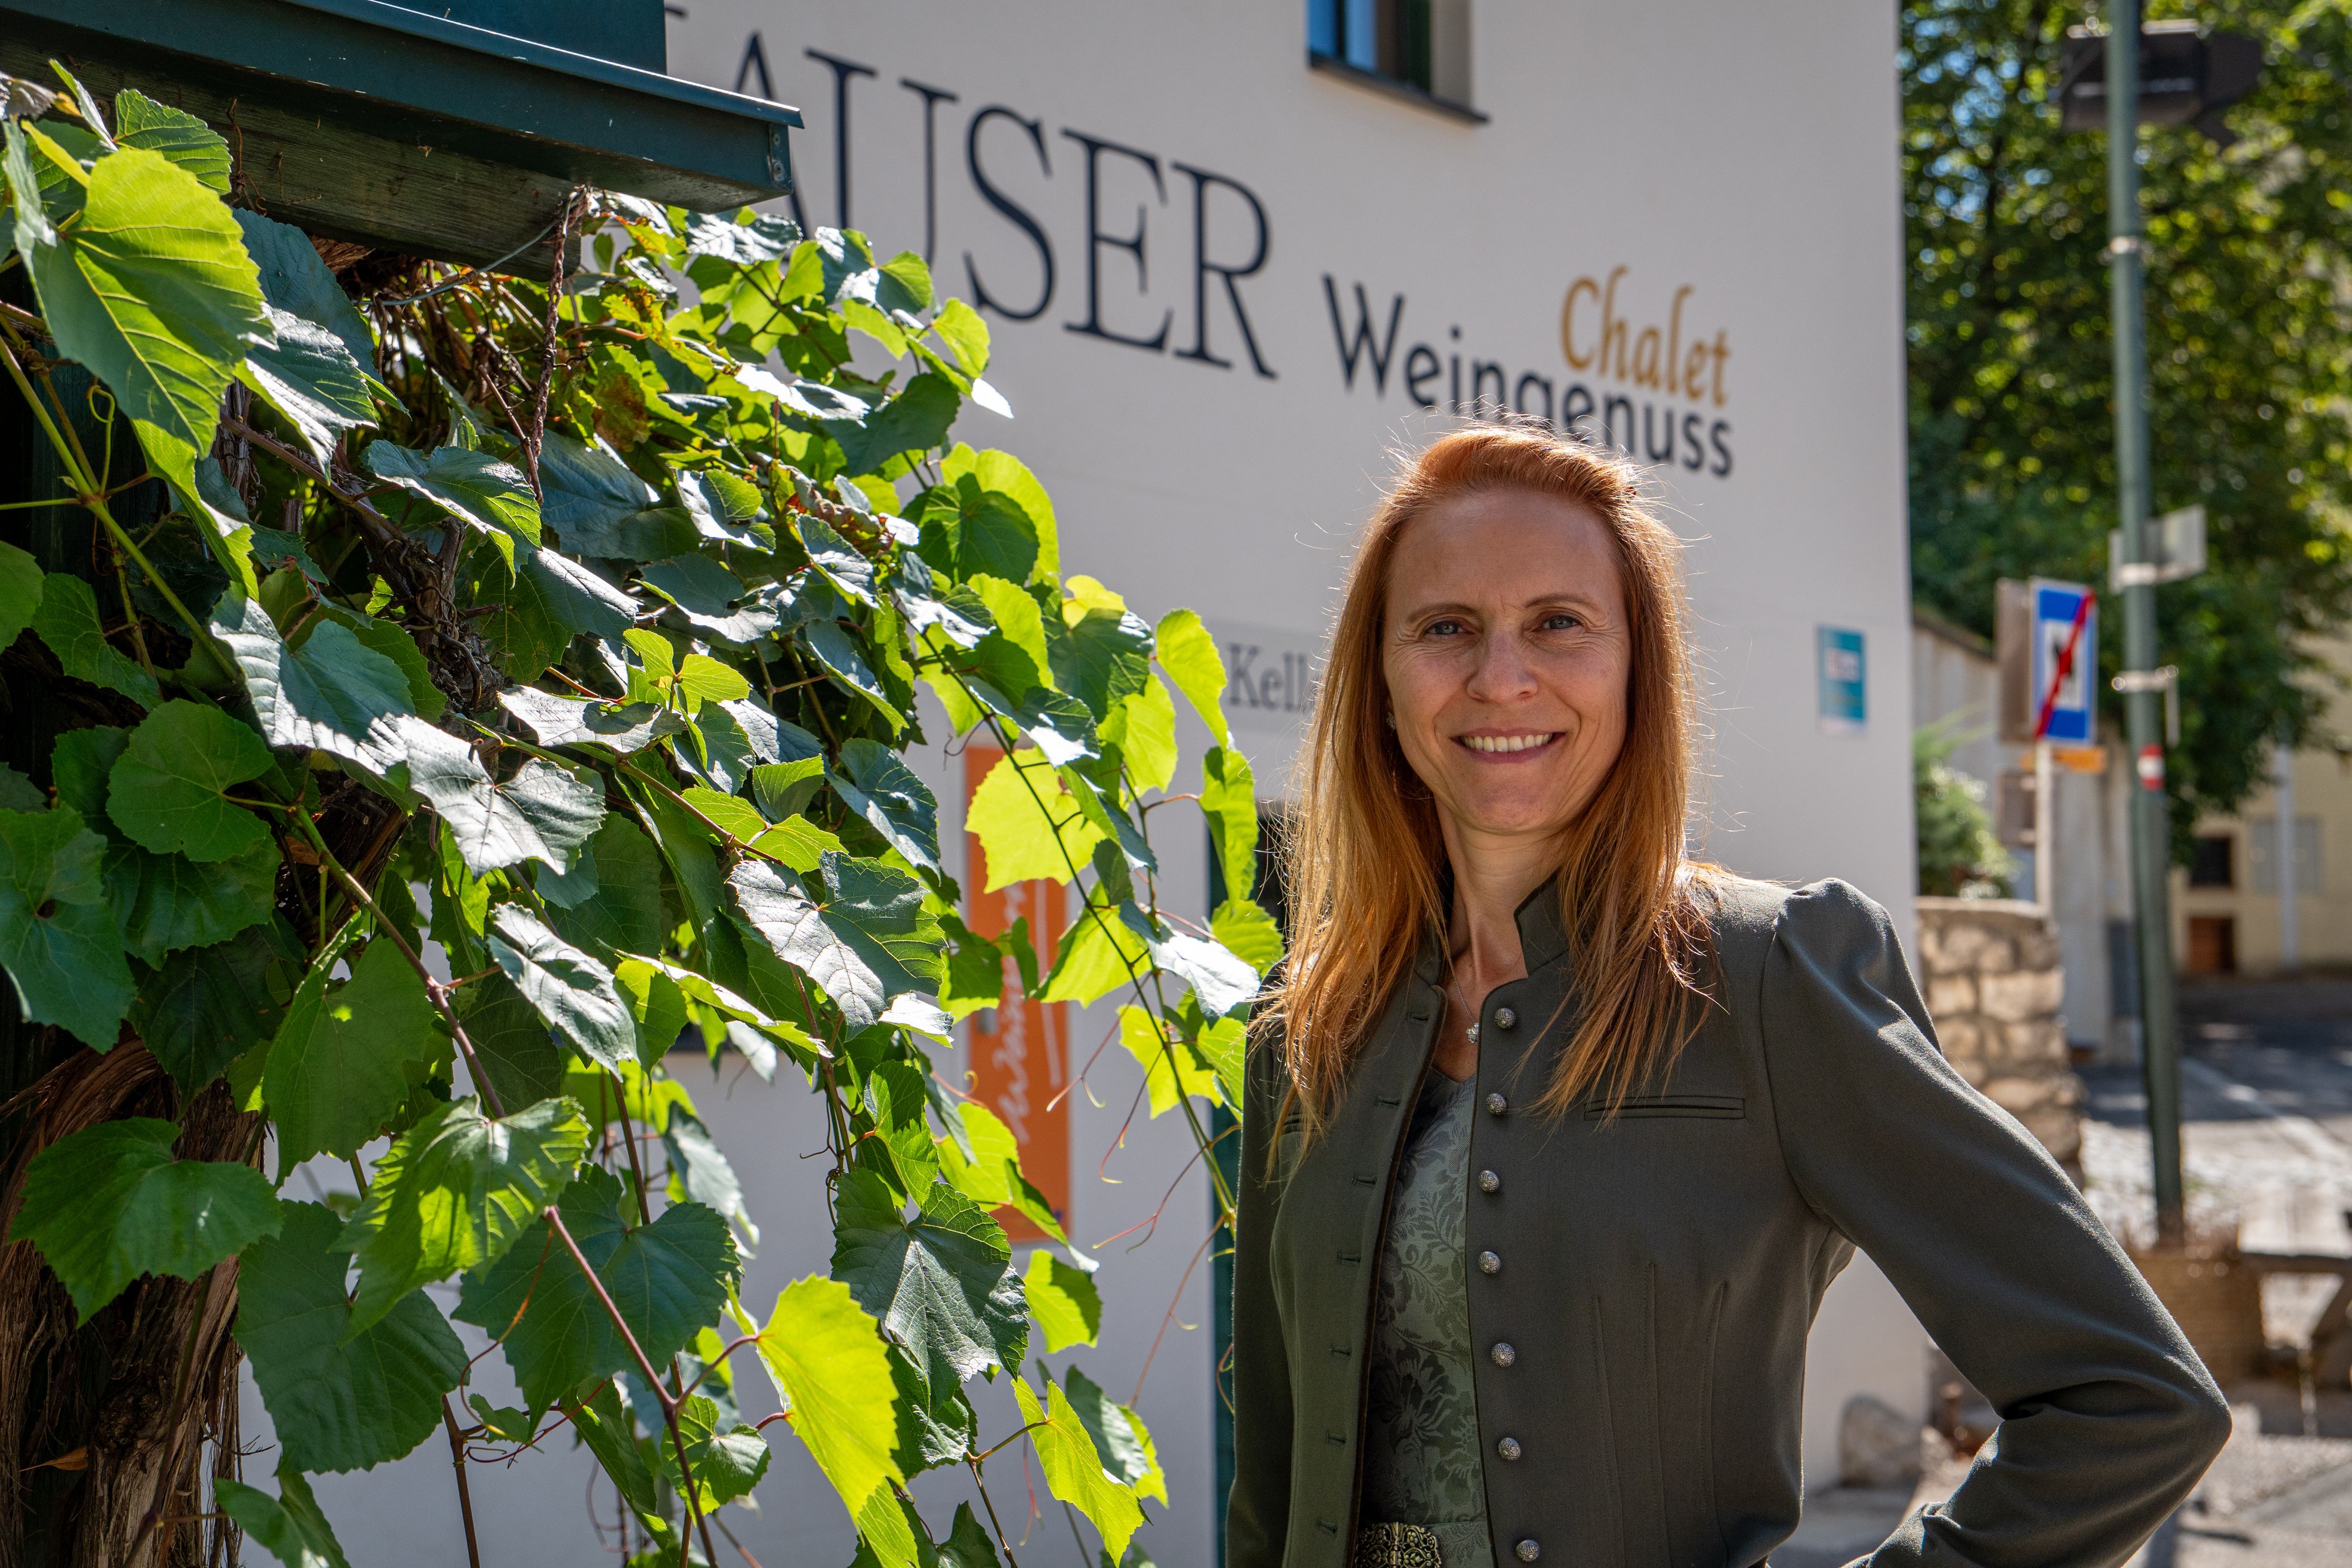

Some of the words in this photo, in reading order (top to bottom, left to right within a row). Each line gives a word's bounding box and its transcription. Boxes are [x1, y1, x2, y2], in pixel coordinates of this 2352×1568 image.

[666, 5, 1278, 381] AUSER
[1322, 270, 1734, 480] Weingenuss
[1561, 263, 1732, 408] Chalet
[1227, 641, 1315, 714] Kell
